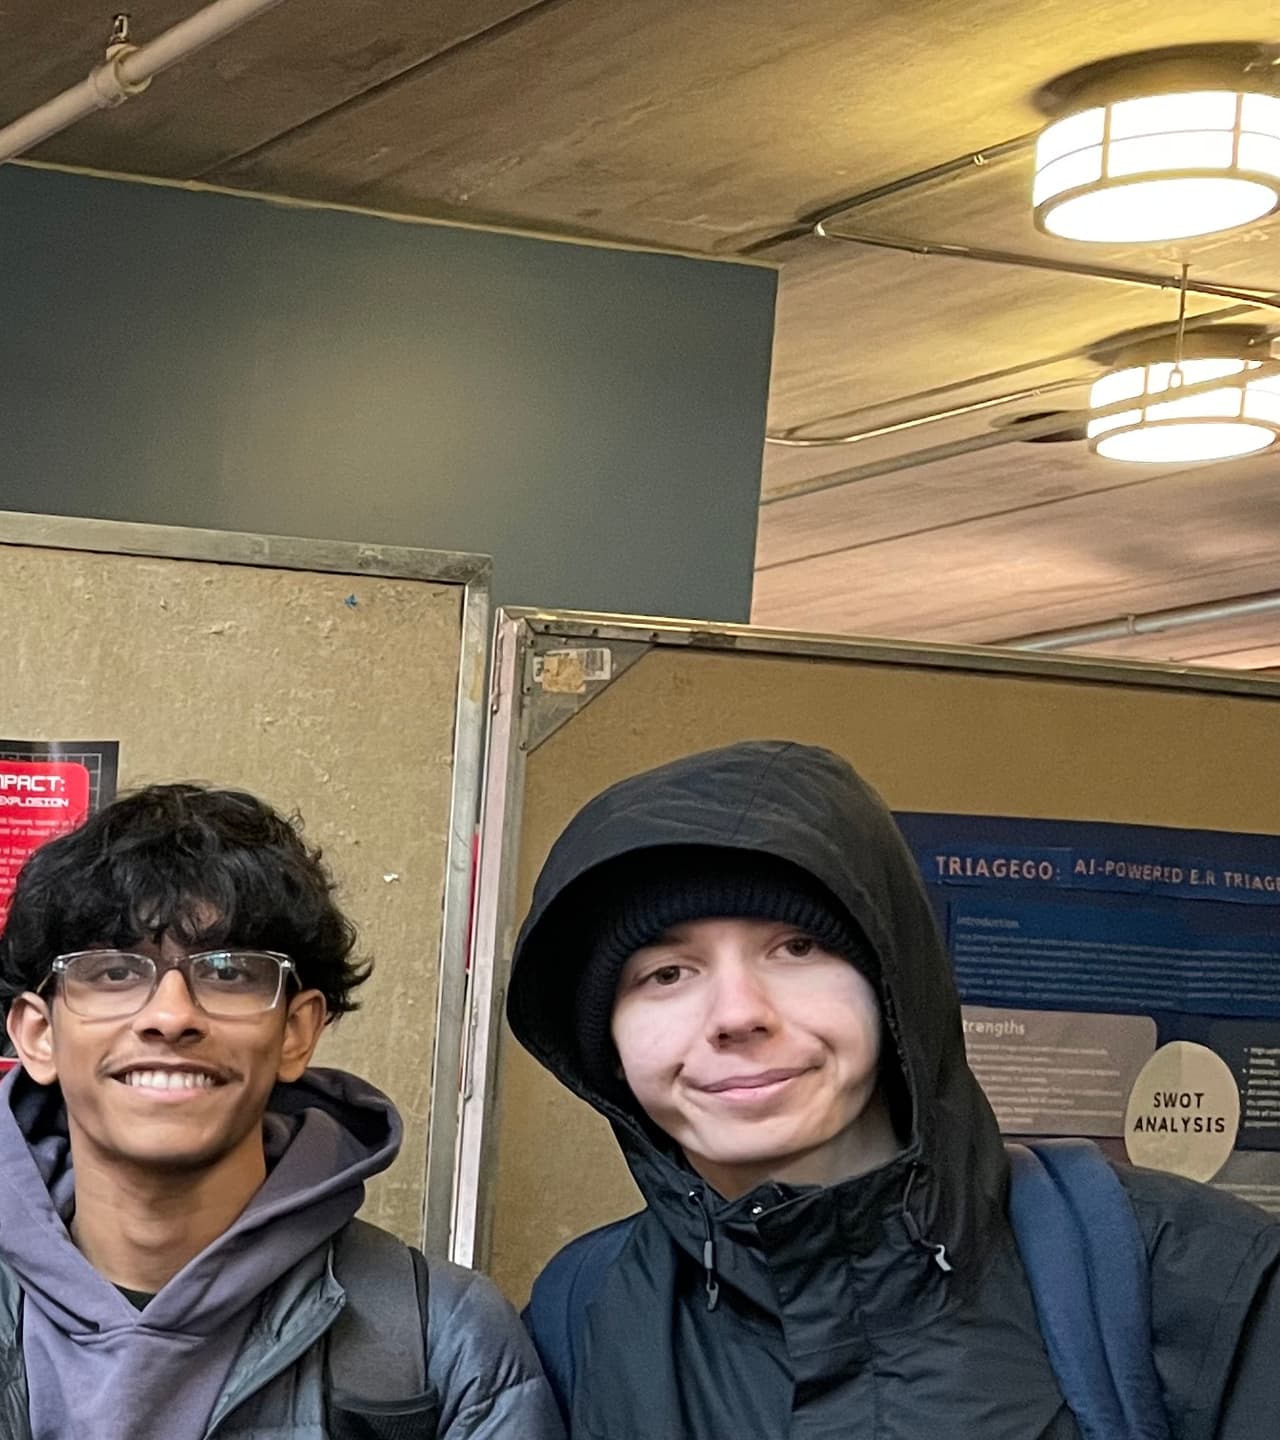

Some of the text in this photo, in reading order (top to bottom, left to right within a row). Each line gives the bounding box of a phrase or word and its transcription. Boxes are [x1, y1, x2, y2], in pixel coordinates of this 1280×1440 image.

[1073, 858, 1184, 885] AI-POWERED
[1153, 1091, 1206, 1109] SWOT
[1133, 1116, 1226, 1134] ANALYSIS
